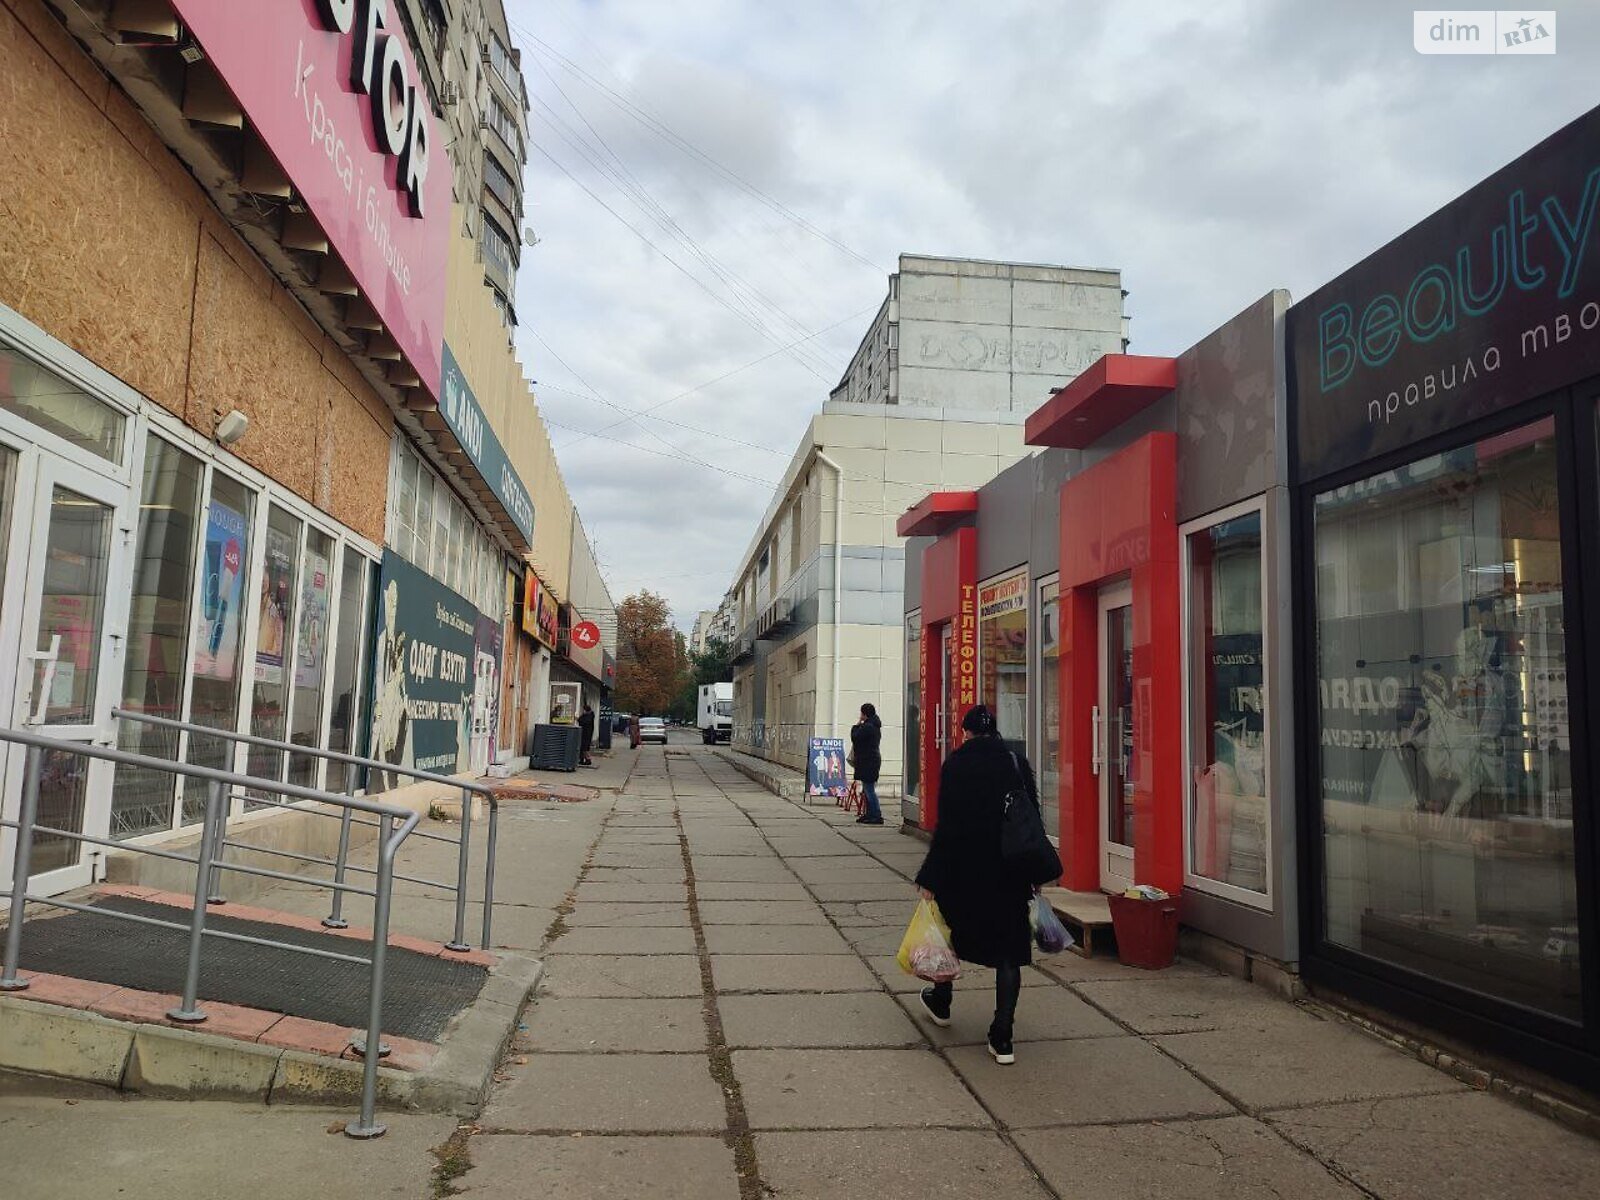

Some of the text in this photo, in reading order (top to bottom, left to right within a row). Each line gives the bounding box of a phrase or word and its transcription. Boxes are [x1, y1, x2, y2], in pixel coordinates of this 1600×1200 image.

[294, 40, 354, 194] Краса
[364, 186, 411, 296] більше
[1319, 166, 1600, 393] Beauty
[1368, 347, 1501, 424] правила
[457, 389, 483, 465] ANDI
[410, 639, 467, 684] ОДЯГ ВЗУТТЯ
[961, 585, 974, 705] ТЕЛЕФОНИ
[822, 739, 841, 747] ANDI
